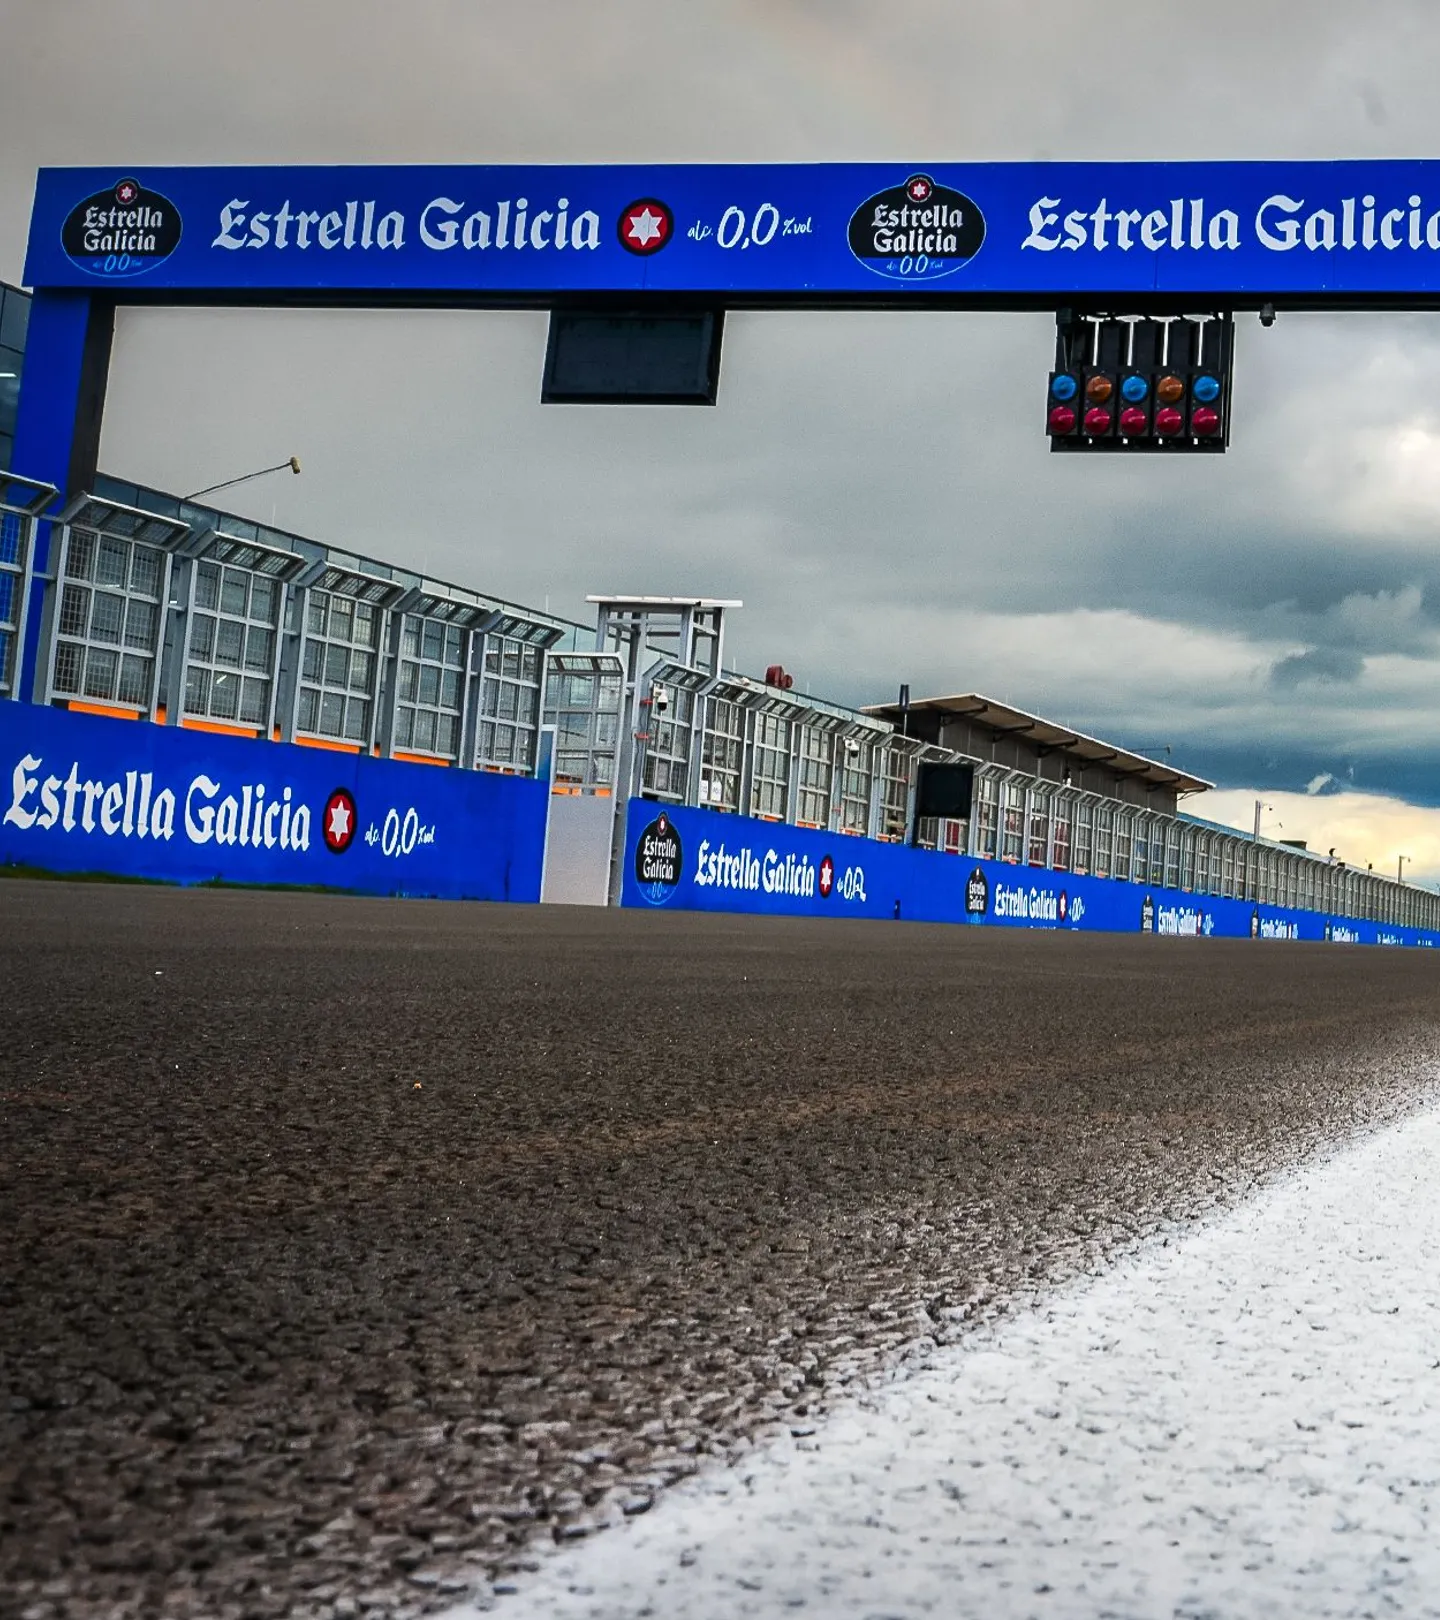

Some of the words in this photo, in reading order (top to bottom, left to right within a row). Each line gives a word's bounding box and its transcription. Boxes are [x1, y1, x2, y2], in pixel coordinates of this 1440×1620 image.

[83, 206, 163, 228] Estrella
[211, 198, 405, 250] Estrella
[419, 197, 601, 250] Galicia
[717, 203, 780, 250] 0,0
[871, 204, 963, 227] Estrella
[1021, 195, 1241, 252] Estrella
[84, 229, 156, 251] Galicia
[873, 228, 957, 252] Galicia
[3, 753, 175, 841] Estrella
[185, 775, 310, 851] Galicia
[382, 807, 419, 858] 0,0
[643, 835, 677, 858] Estrella
[643, 856, 674, 879] Galicia
[694, 839, 760, 890] Estrella
[762, 849, 815, 897] Galicia
[994, 883, 1028, 918] Estrella
[1029, 887, 1057, 920] Galicia
